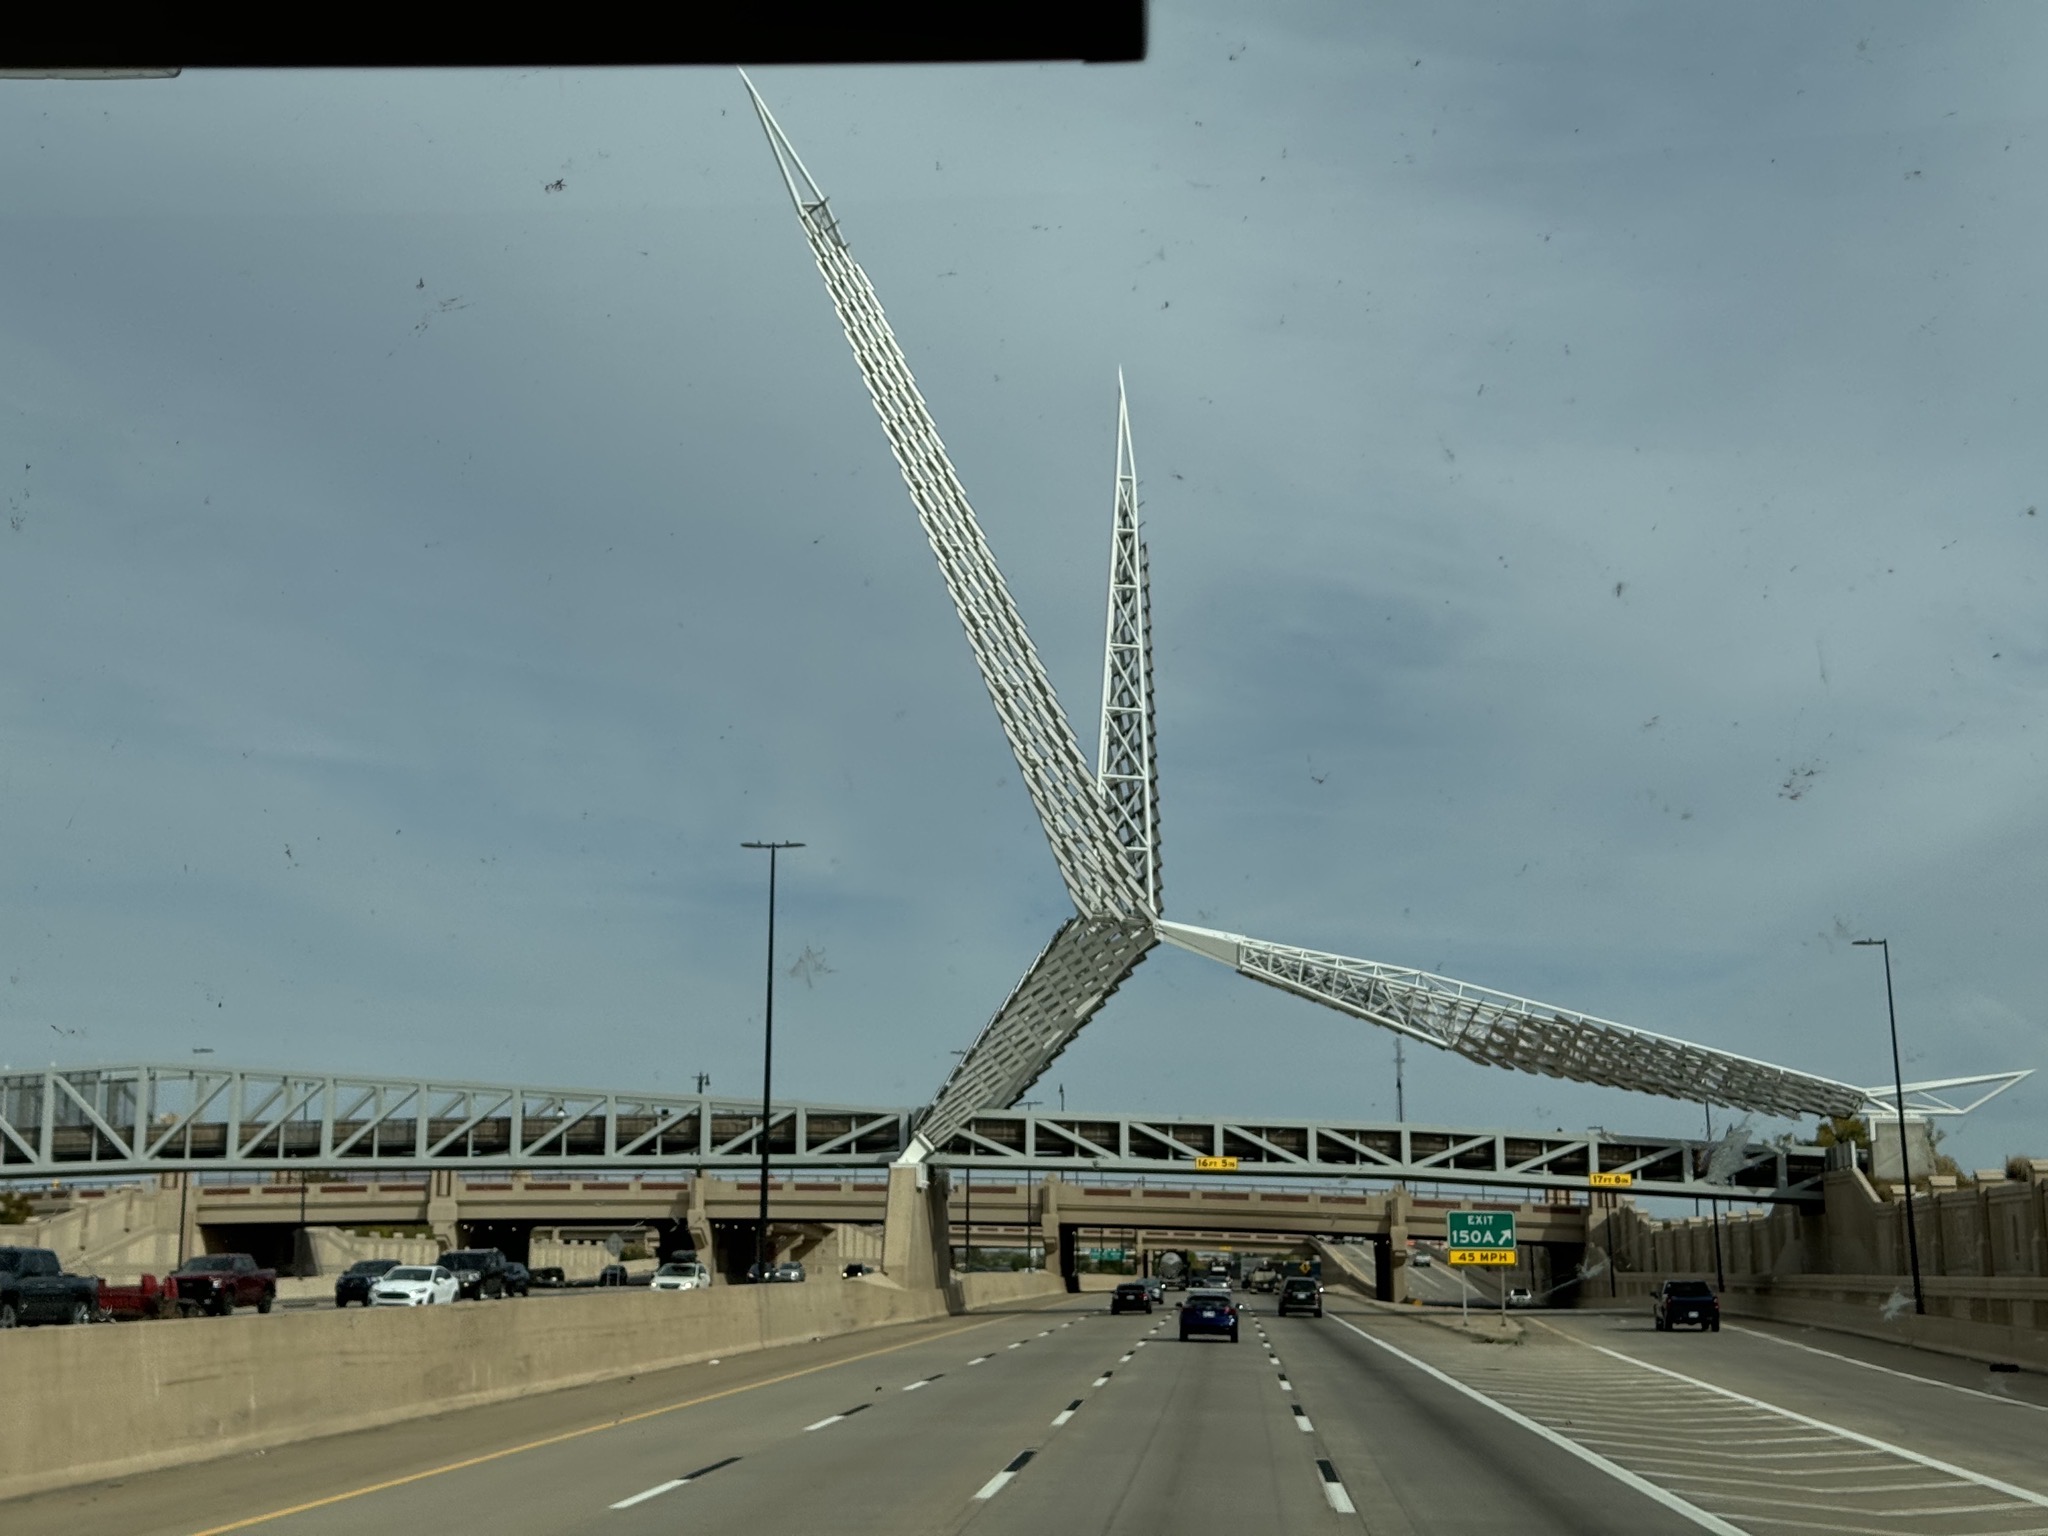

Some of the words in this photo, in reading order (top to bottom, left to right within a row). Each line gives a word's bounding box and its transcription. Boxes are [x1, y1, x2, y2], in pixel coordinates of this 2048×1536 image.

[1467, 1215, 1494, 1225] EXIT
[1452, 1230, 1495, 1243] 150A
[1458, 1252, 1475, 1262] 45
[1480, 1252, 1507, 1262] MPH
